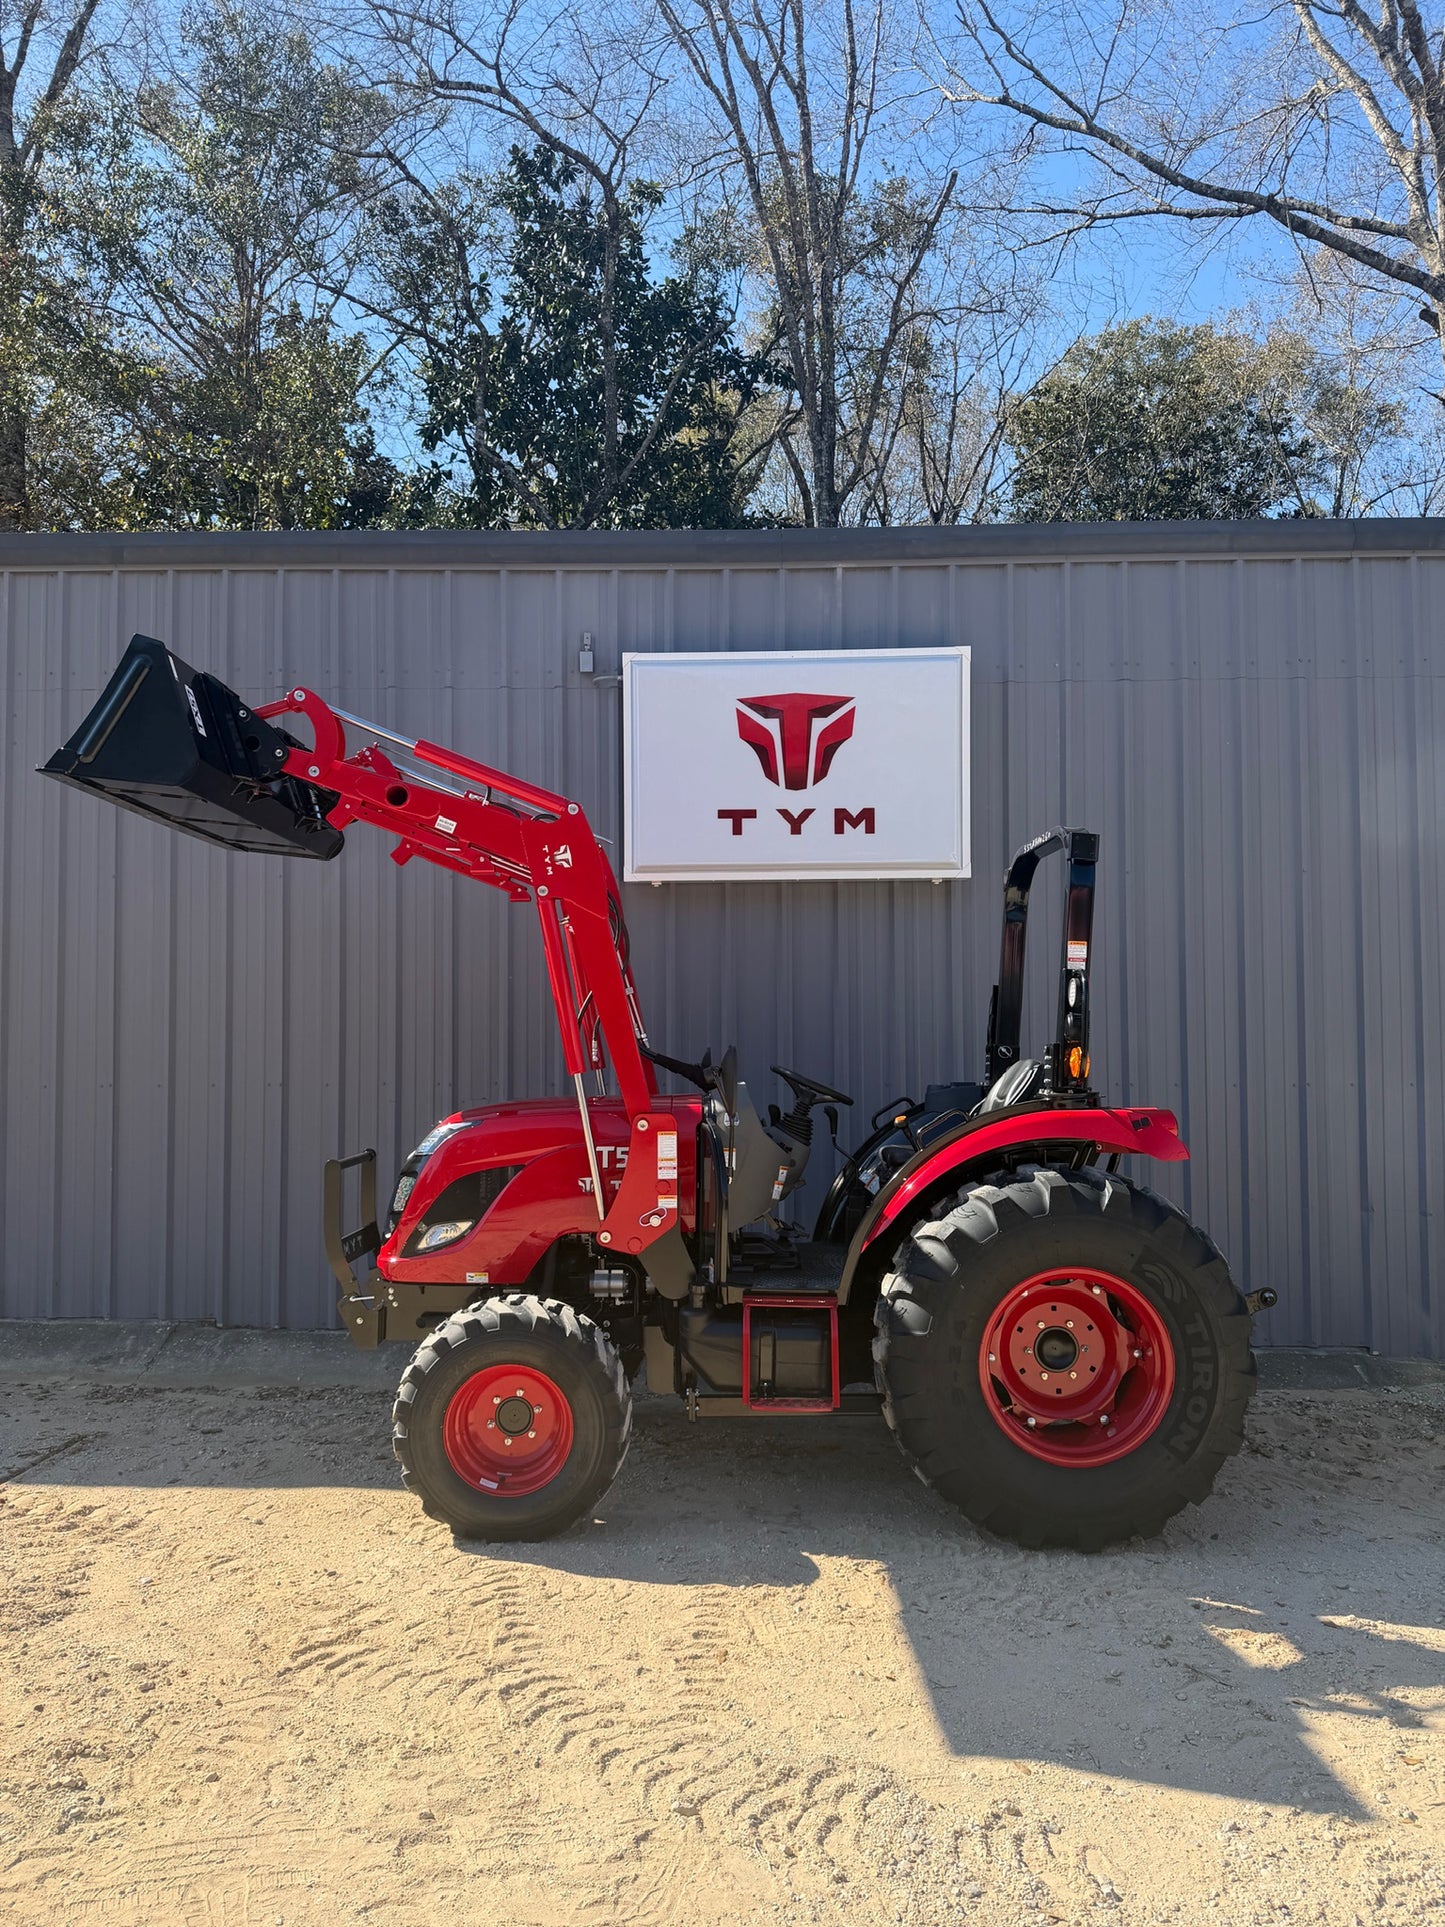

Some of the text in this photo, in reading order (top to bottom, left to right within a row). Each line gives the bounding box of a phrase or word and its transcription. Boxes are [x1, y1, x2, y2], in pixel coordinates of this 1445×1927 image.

[717, 808, 875, 836] TYM
[542, 844, 554, 876] TYM
[1168, 1312, 1214, 1451] TIRON
